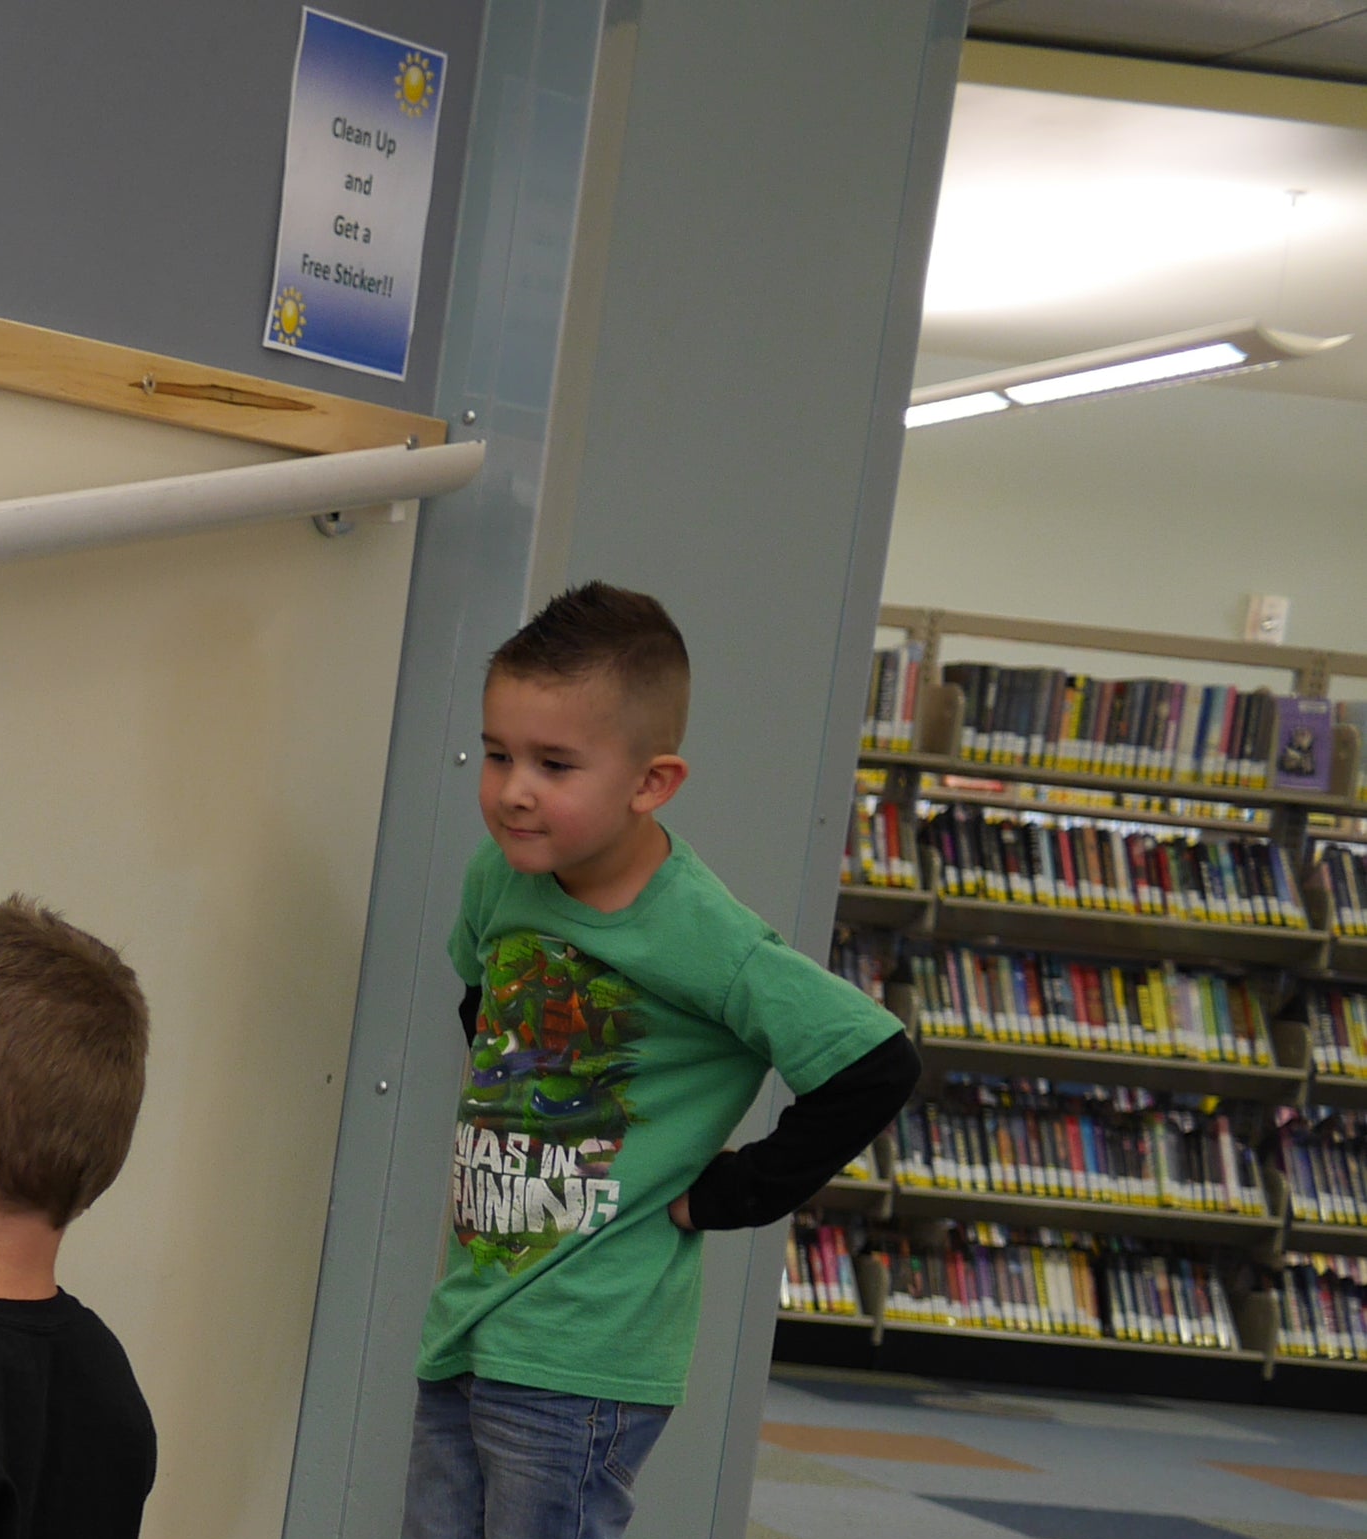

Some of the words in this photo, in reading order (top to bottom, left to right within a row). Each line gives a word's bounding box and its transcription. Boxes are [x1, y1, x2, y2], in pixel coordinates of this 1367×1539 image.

[331, 116, 372, 148] Clean
[375, 129, 397, 159] Up
[344, 173, 373, 196] and
[333, 214, 360, 241] Get
[362, 227, 372, 244] a
[300, 253, 331, 281] Free
[333, 263, 394, 298] Sticker!!
[540, 1143, 578, 1179] IN
